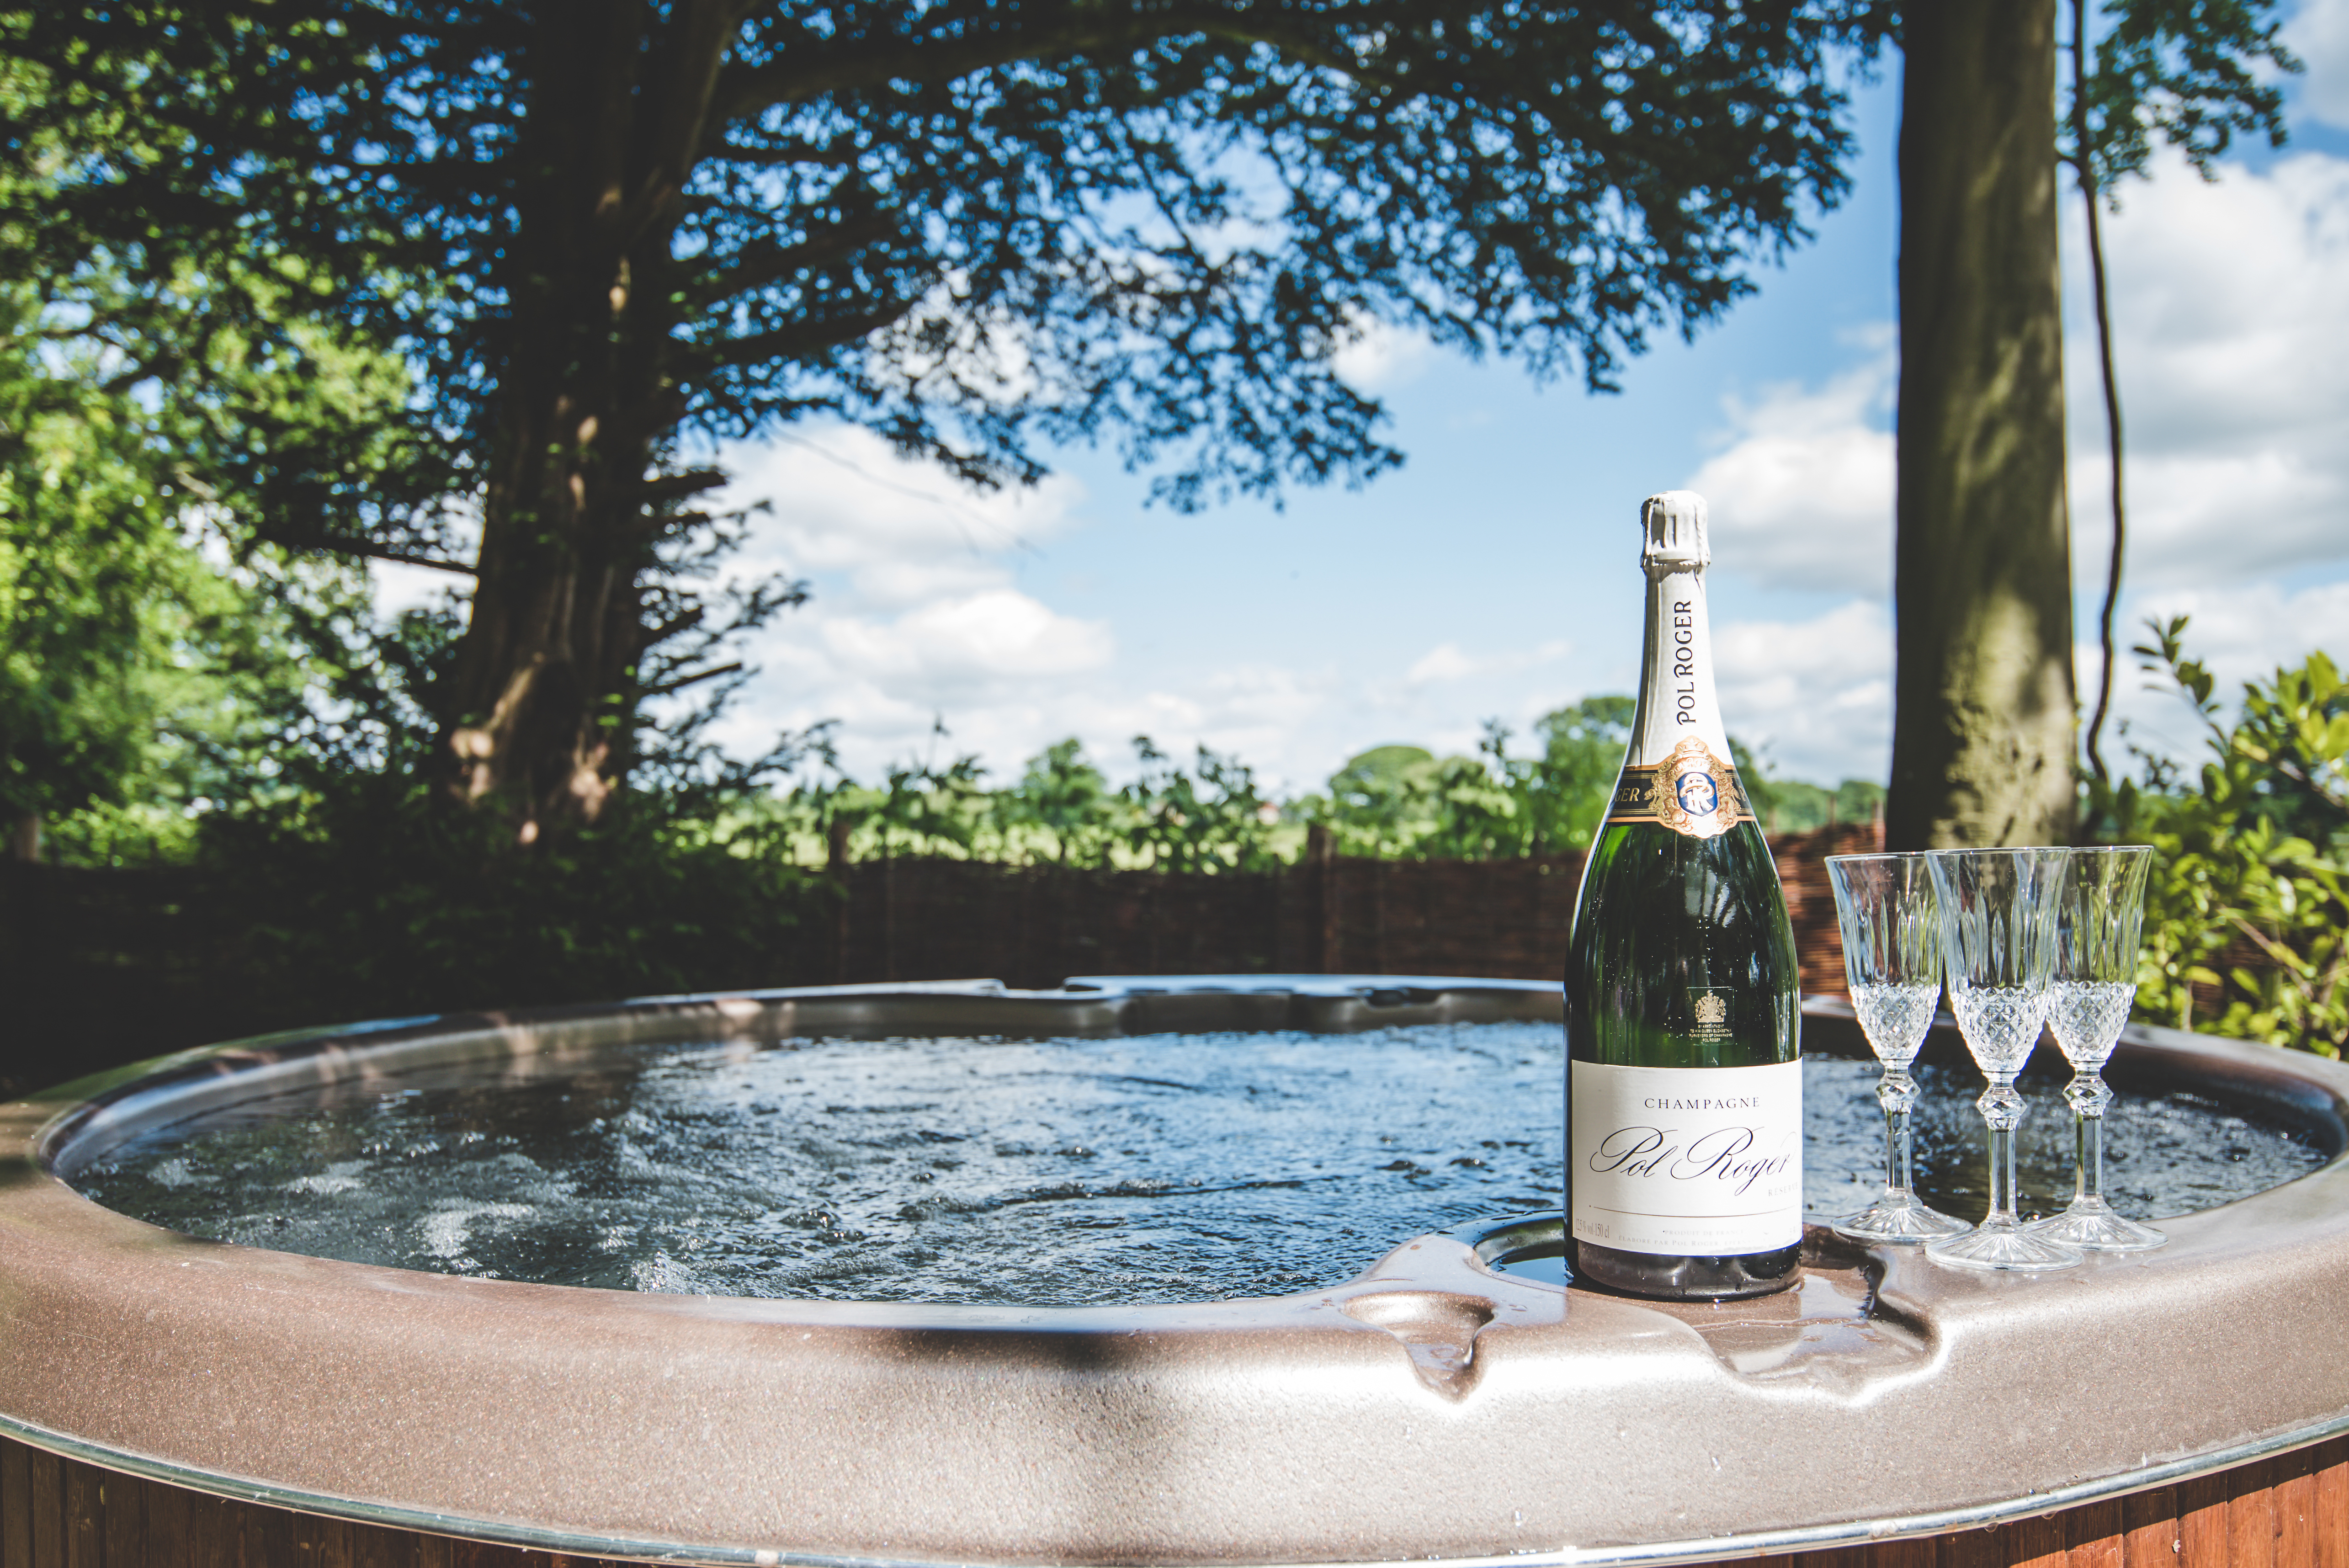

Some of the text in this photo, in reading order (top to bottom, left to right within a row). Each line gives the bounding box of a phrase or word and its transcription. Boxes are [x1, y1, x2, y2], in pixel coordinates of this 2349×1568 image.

[1674, 601, 1696, 725] POL ROGER
[1644, 1097, 1760, 1109] CHAMPAGNE
[1589, 1126, 1798, 1196] Pol Roger
[1605, 1225, 1610, 1238] cl
